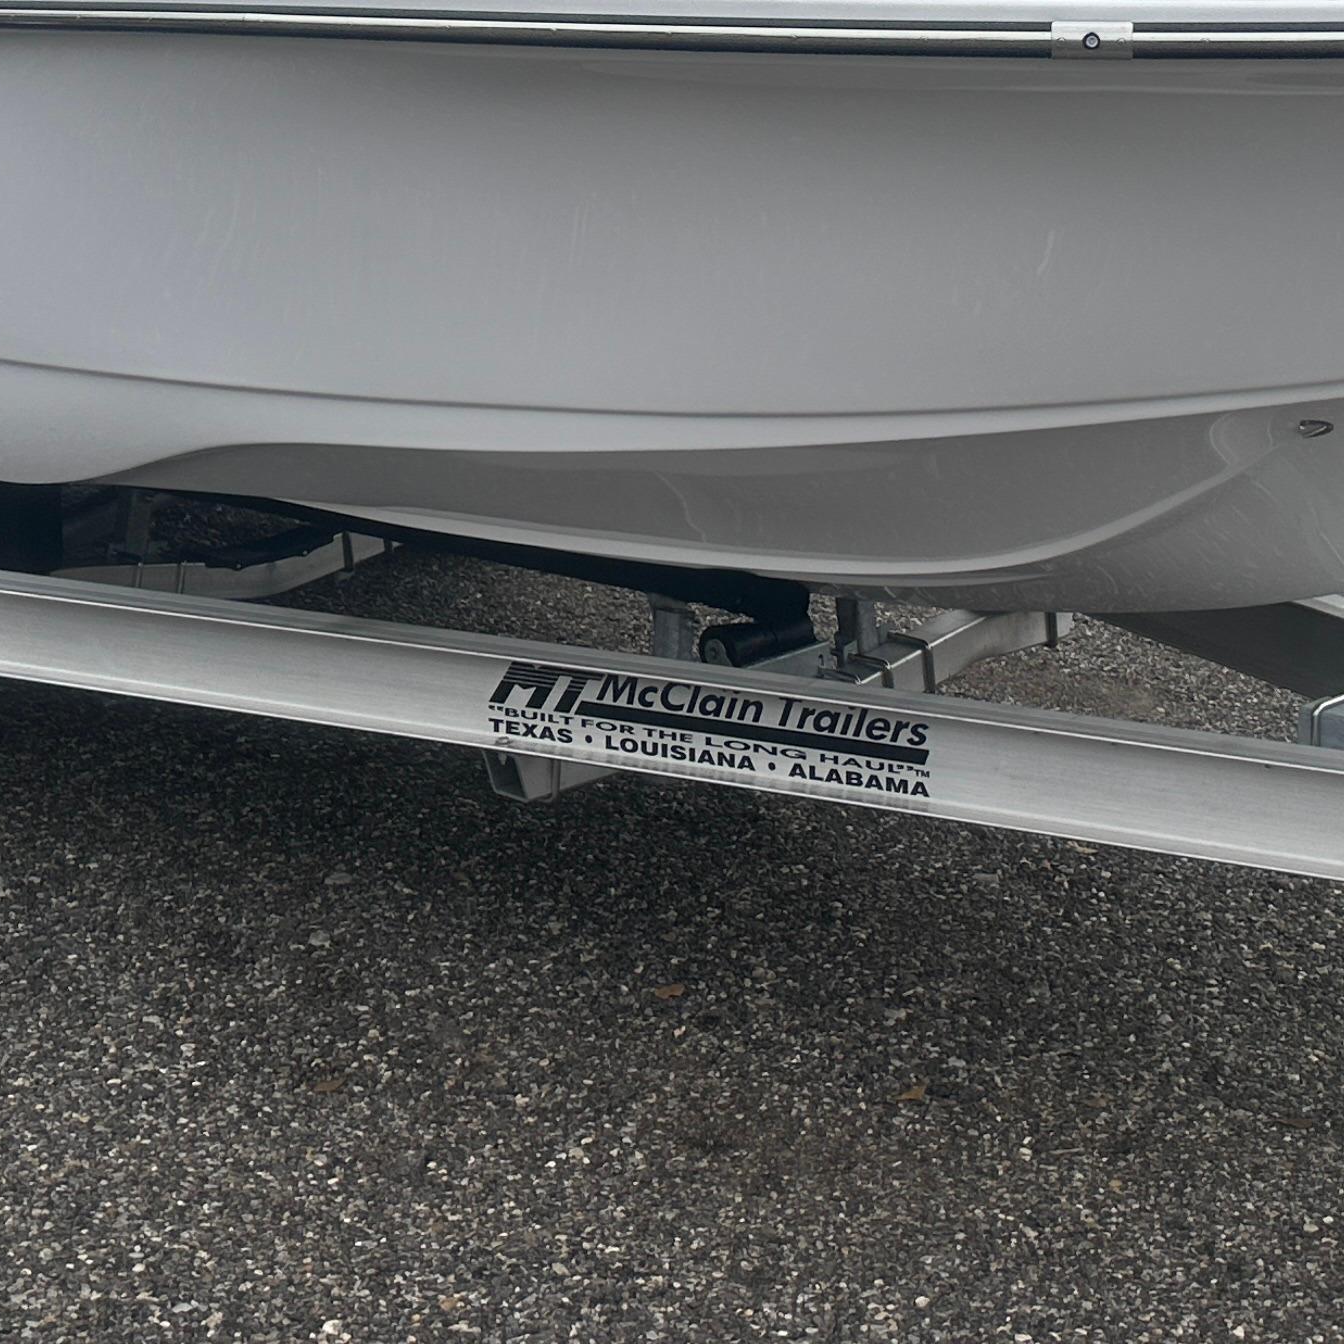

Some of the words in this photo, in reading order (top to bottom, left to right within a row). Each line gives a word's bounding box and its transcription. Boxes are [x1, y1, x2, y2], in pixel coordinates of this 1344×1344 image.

[581, 718, 635, 735] FOR
[642, 727, 694, 744] THE
[705, 736, 806, 760] LONG
[596, 673, 764, 724] McClain
[777, 696, 930, 747] Trailers
[488, 717, 574, 744] TEXAS
[605, 734, 756, 773] LOUISIANA
[788, 763, 931, 798] ALABAMA
